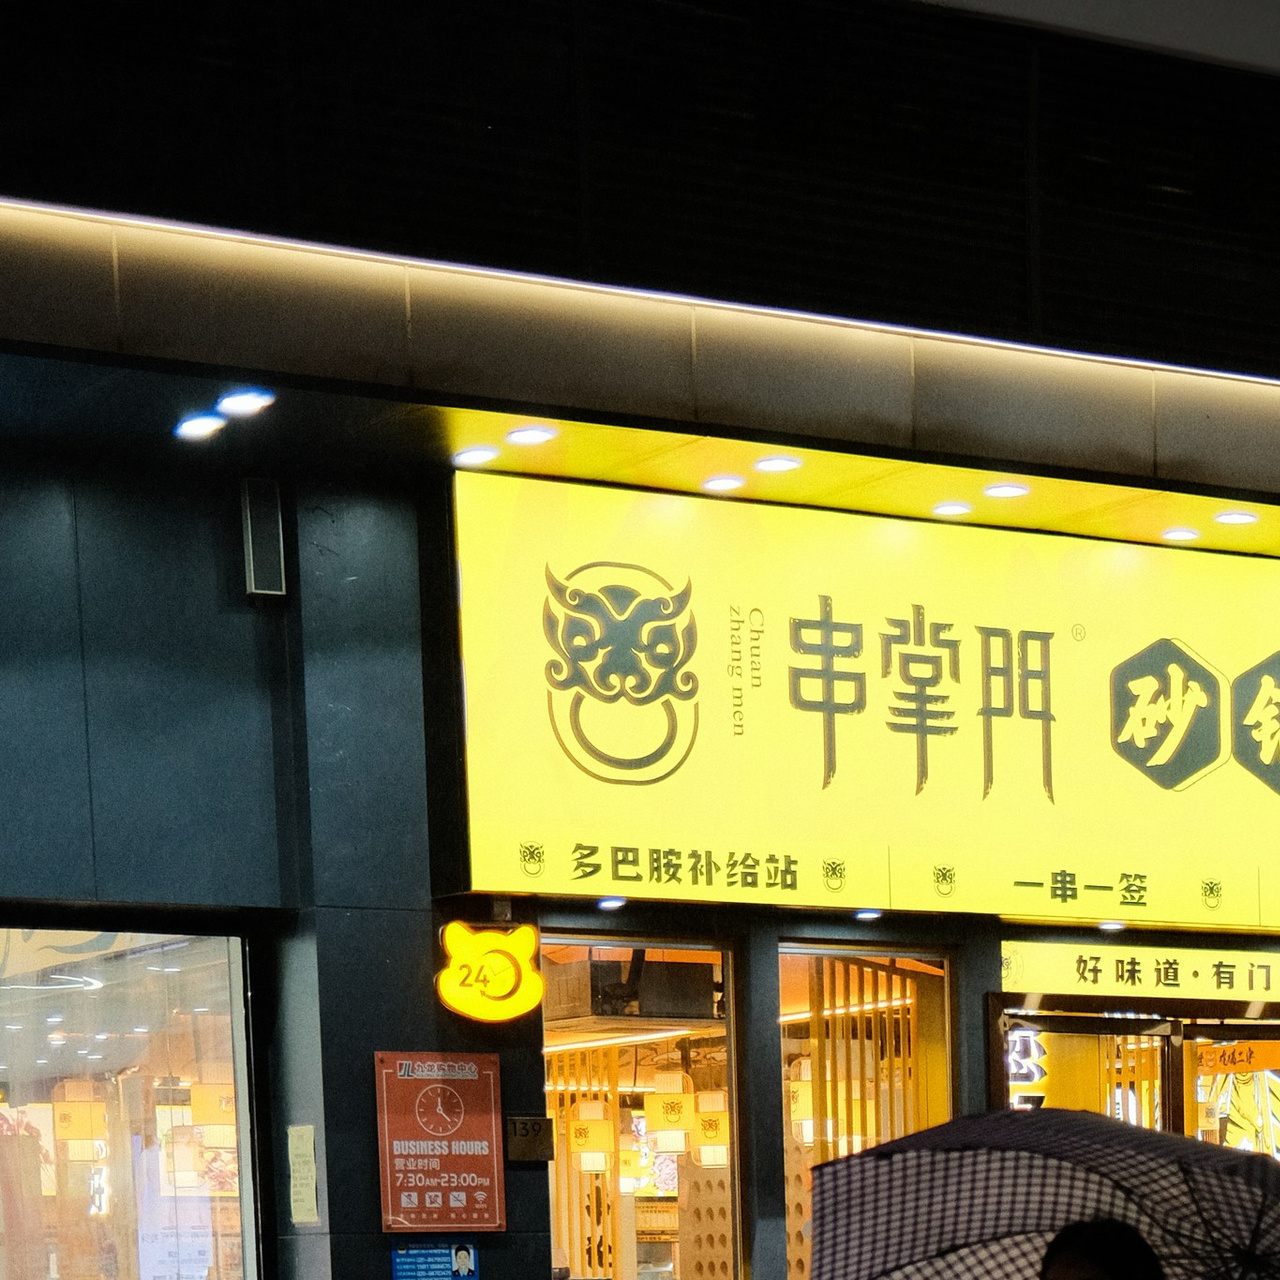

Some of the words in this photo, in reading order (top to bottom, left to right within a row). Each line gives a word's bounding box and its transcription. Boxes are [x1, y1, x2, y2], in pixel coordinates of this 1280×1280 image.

[727, 604, 745, 679] zhang
[749, 607, 765, 689] Chuan
[732, 687, 745, 737] men
[570, 842, 799, 891] 多巴胺补给站
[1012, 869, 1148, 908] 一串一签
[458, 963, 490, 988] 24
[393, 1140, 449, 1155] BUSINESS
[451, 1140, 489, 1155] HOURS
[394, 1158, 440, 1171] 营业时间
